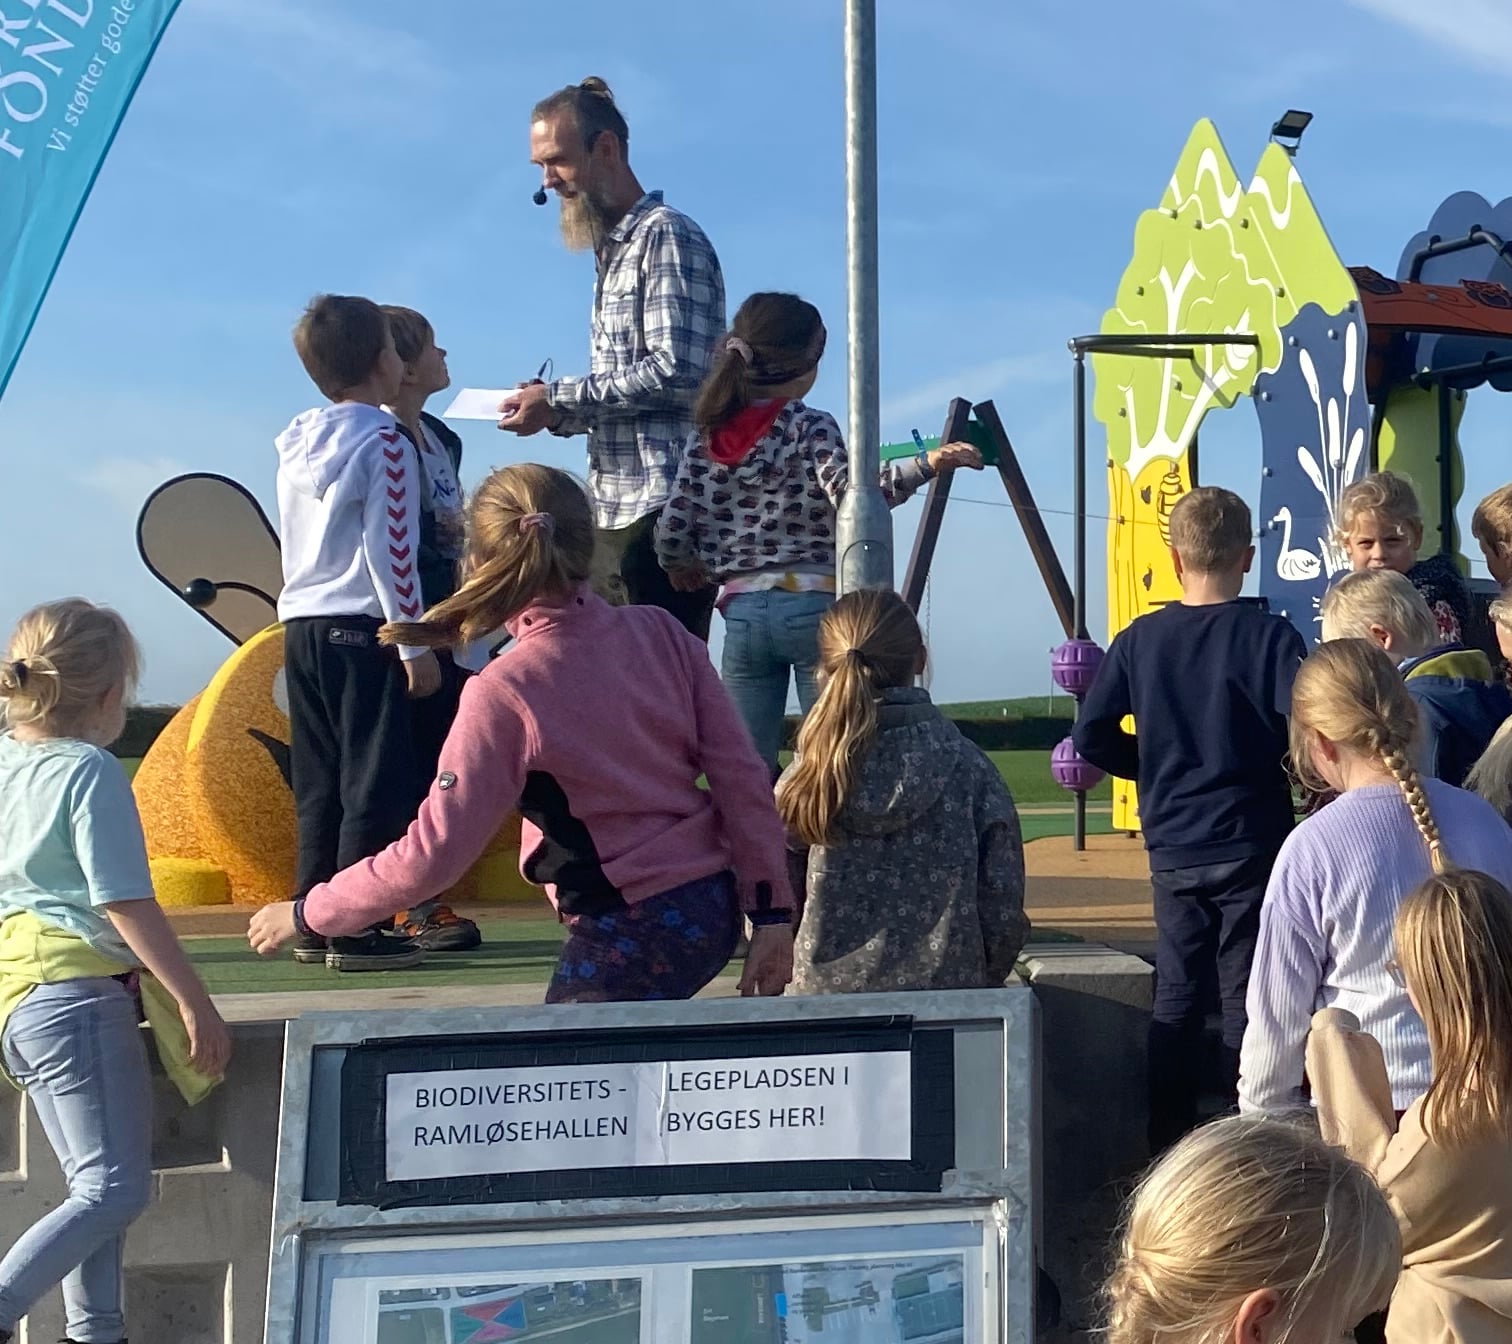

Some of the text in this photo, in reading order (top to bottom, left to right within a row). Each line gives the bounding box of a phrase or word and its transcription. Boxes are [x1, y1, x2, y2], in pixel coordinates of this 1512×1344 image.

[46, 127, 73, 153] Vi
[64, 52, 108, 128] støtter
[415, 1079, 612, 1108] BIODIVERSITETS
[668, 1066, 835, 1092] LEGEPLADSEN
[844, 1066, 849, 1086] I
[414, 1105, 825, 1147] RAMLØSEHALLEN BYGGES HER!
